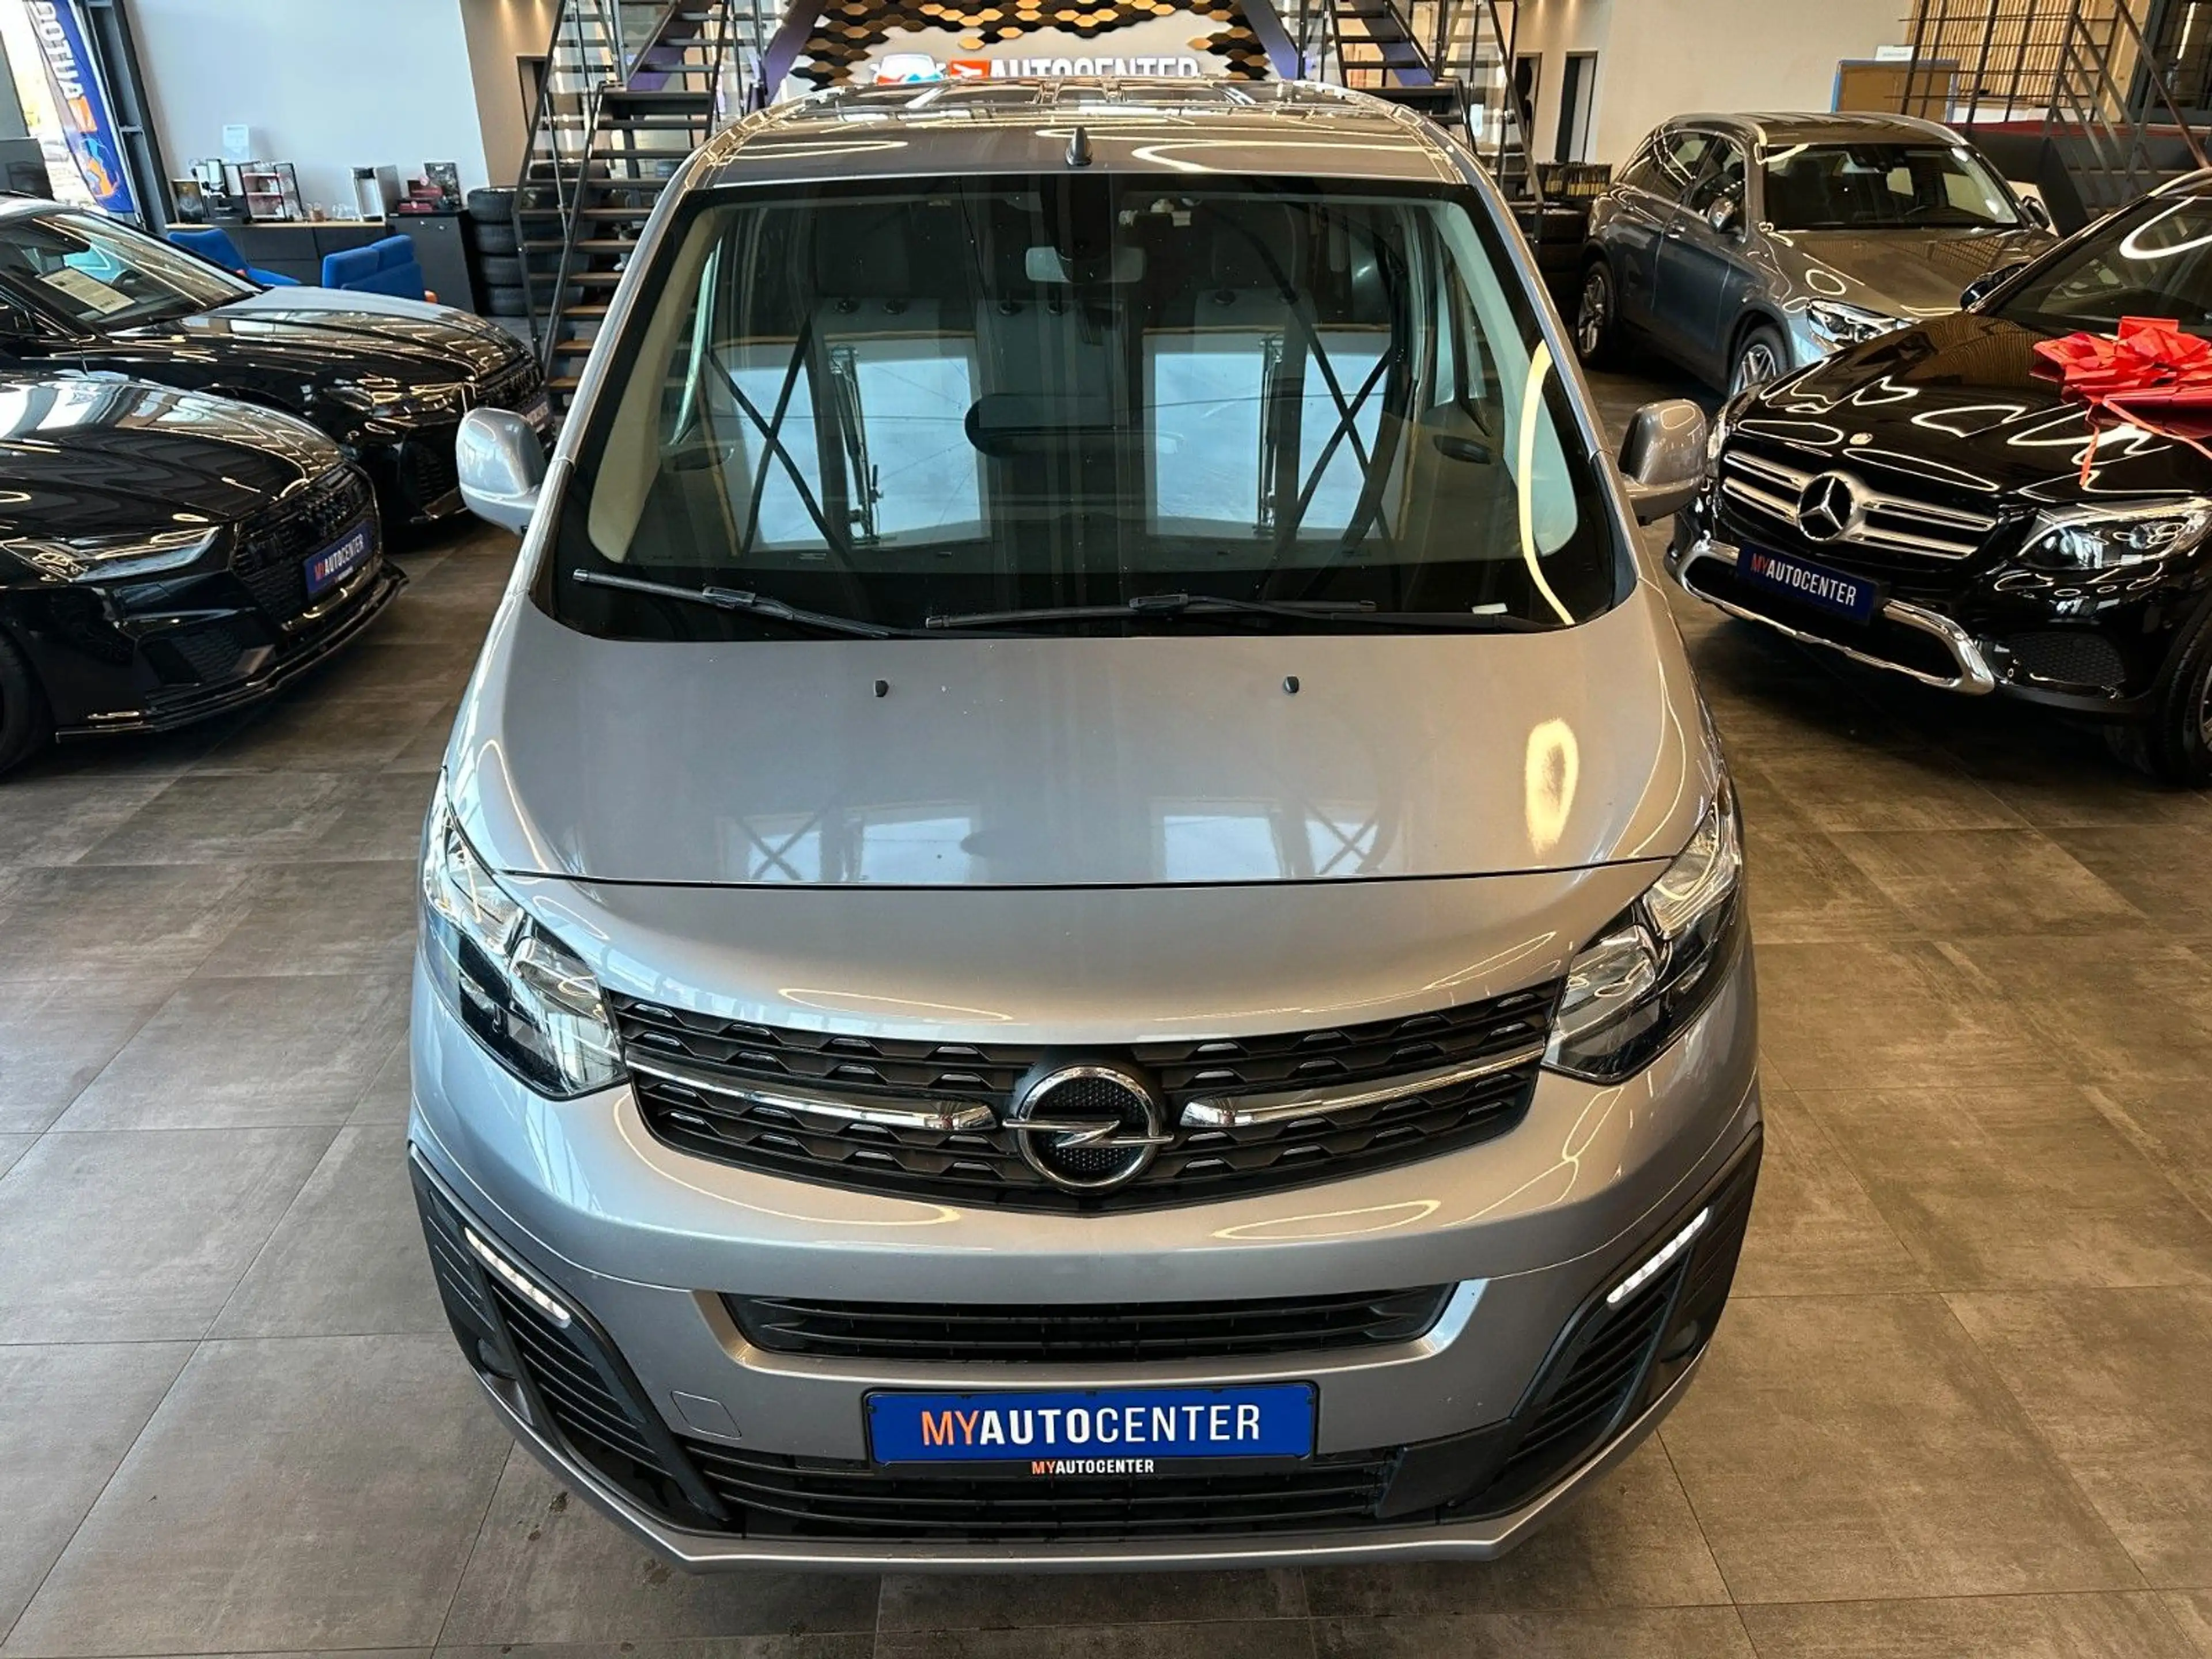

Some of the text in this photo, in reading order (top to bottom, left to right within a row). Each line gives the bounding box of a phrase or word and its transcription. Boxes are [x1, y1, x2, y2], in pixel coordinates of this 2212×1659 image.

[1751, 553, 1857, 607] MYAUTOCENTER
[921, 1404, 1261, 1446] MYAUTOCENTER
[1031, 1459, 1154, 1475] MYAUTOCENTER
